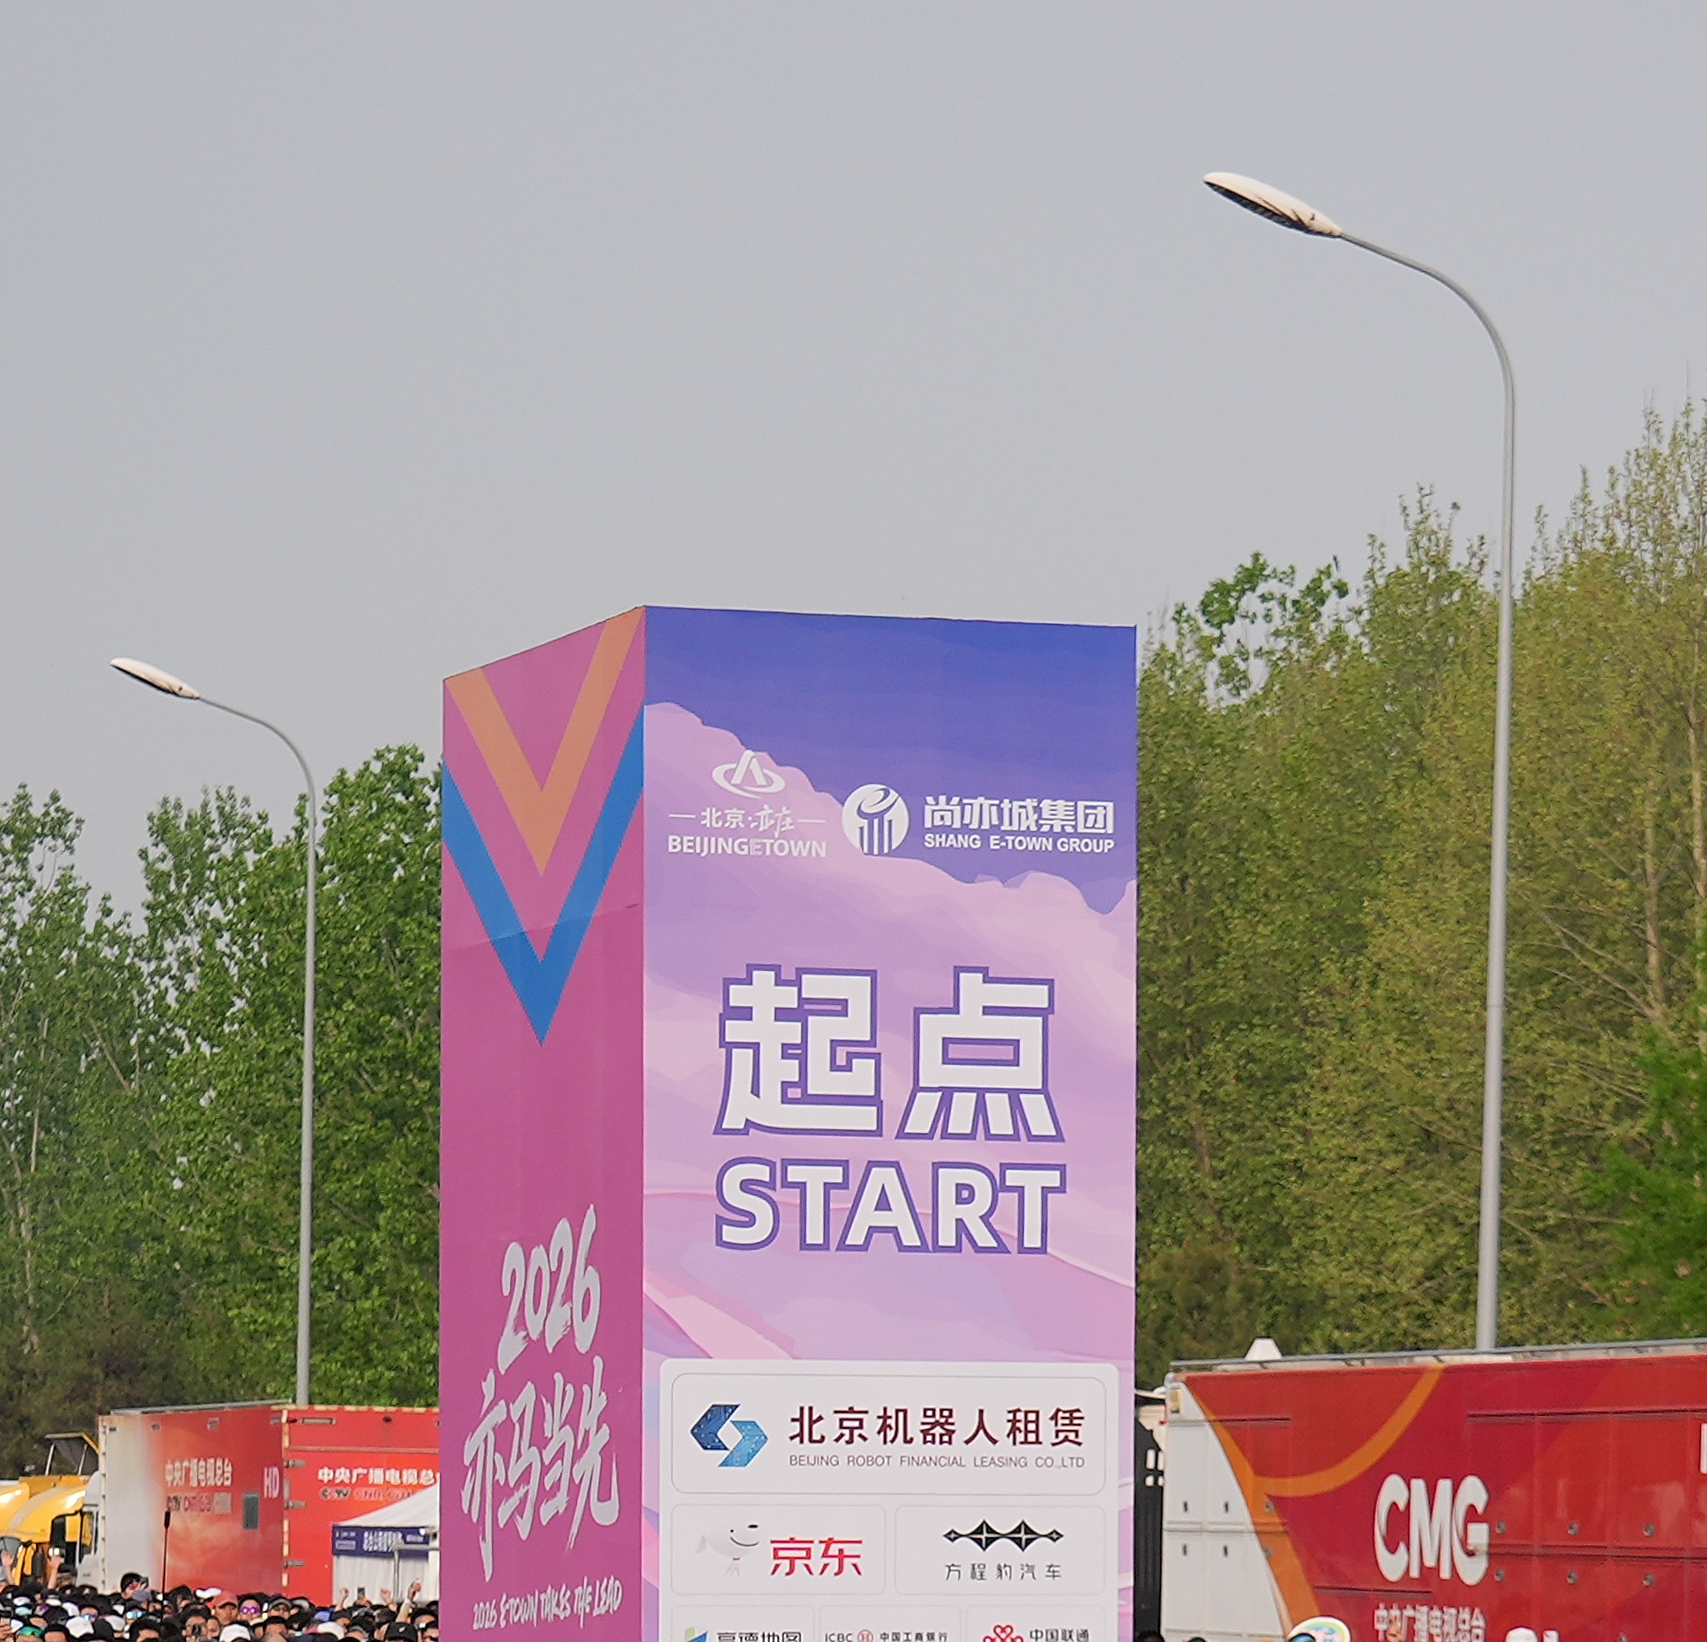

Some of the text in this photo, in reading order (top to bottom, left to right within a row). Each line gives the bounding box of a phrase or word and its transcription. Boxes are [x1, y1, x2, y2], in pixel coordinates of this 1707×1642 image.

[924, 795, 1115, 835] 尚亦城集团
[668, 835, 827, 858] BEIJINGETOWN
[924, 833, 1115, 854] SHANG E-TOWN GROUP
[714, 964, 1066, 1143] 起点
[715, 1156, 1067, 1255] START
[497, 1204, 602, 1375] 2026
[789, 1405, 1086, 1447] 北京机器人租赁
[317, 1467, 440, 1486] 中央广播电视总
[461, 1356, 620, 1582] 亦马当先
[789, 1454, 839, 1467] BEIJING
[847, 1454, 892, 1467] ROBOT
[899, 1455, 966, 1468] FINANCIAL
[973, 1456, 1028, 1469] LEASING
[263, 1466, 280, 1499] HD
[1374, 1473, 1490, 1586] CMG
[770, 1536, 863, 1577] 京东
[945, 1562, 1063, 1581] 方程豹汽车
[473, 1598, 497, 1630] 2026
[879, 1631, 948, 1642] 中国工商银行
[1029, 1628, 1090, 1642] 中国联通
